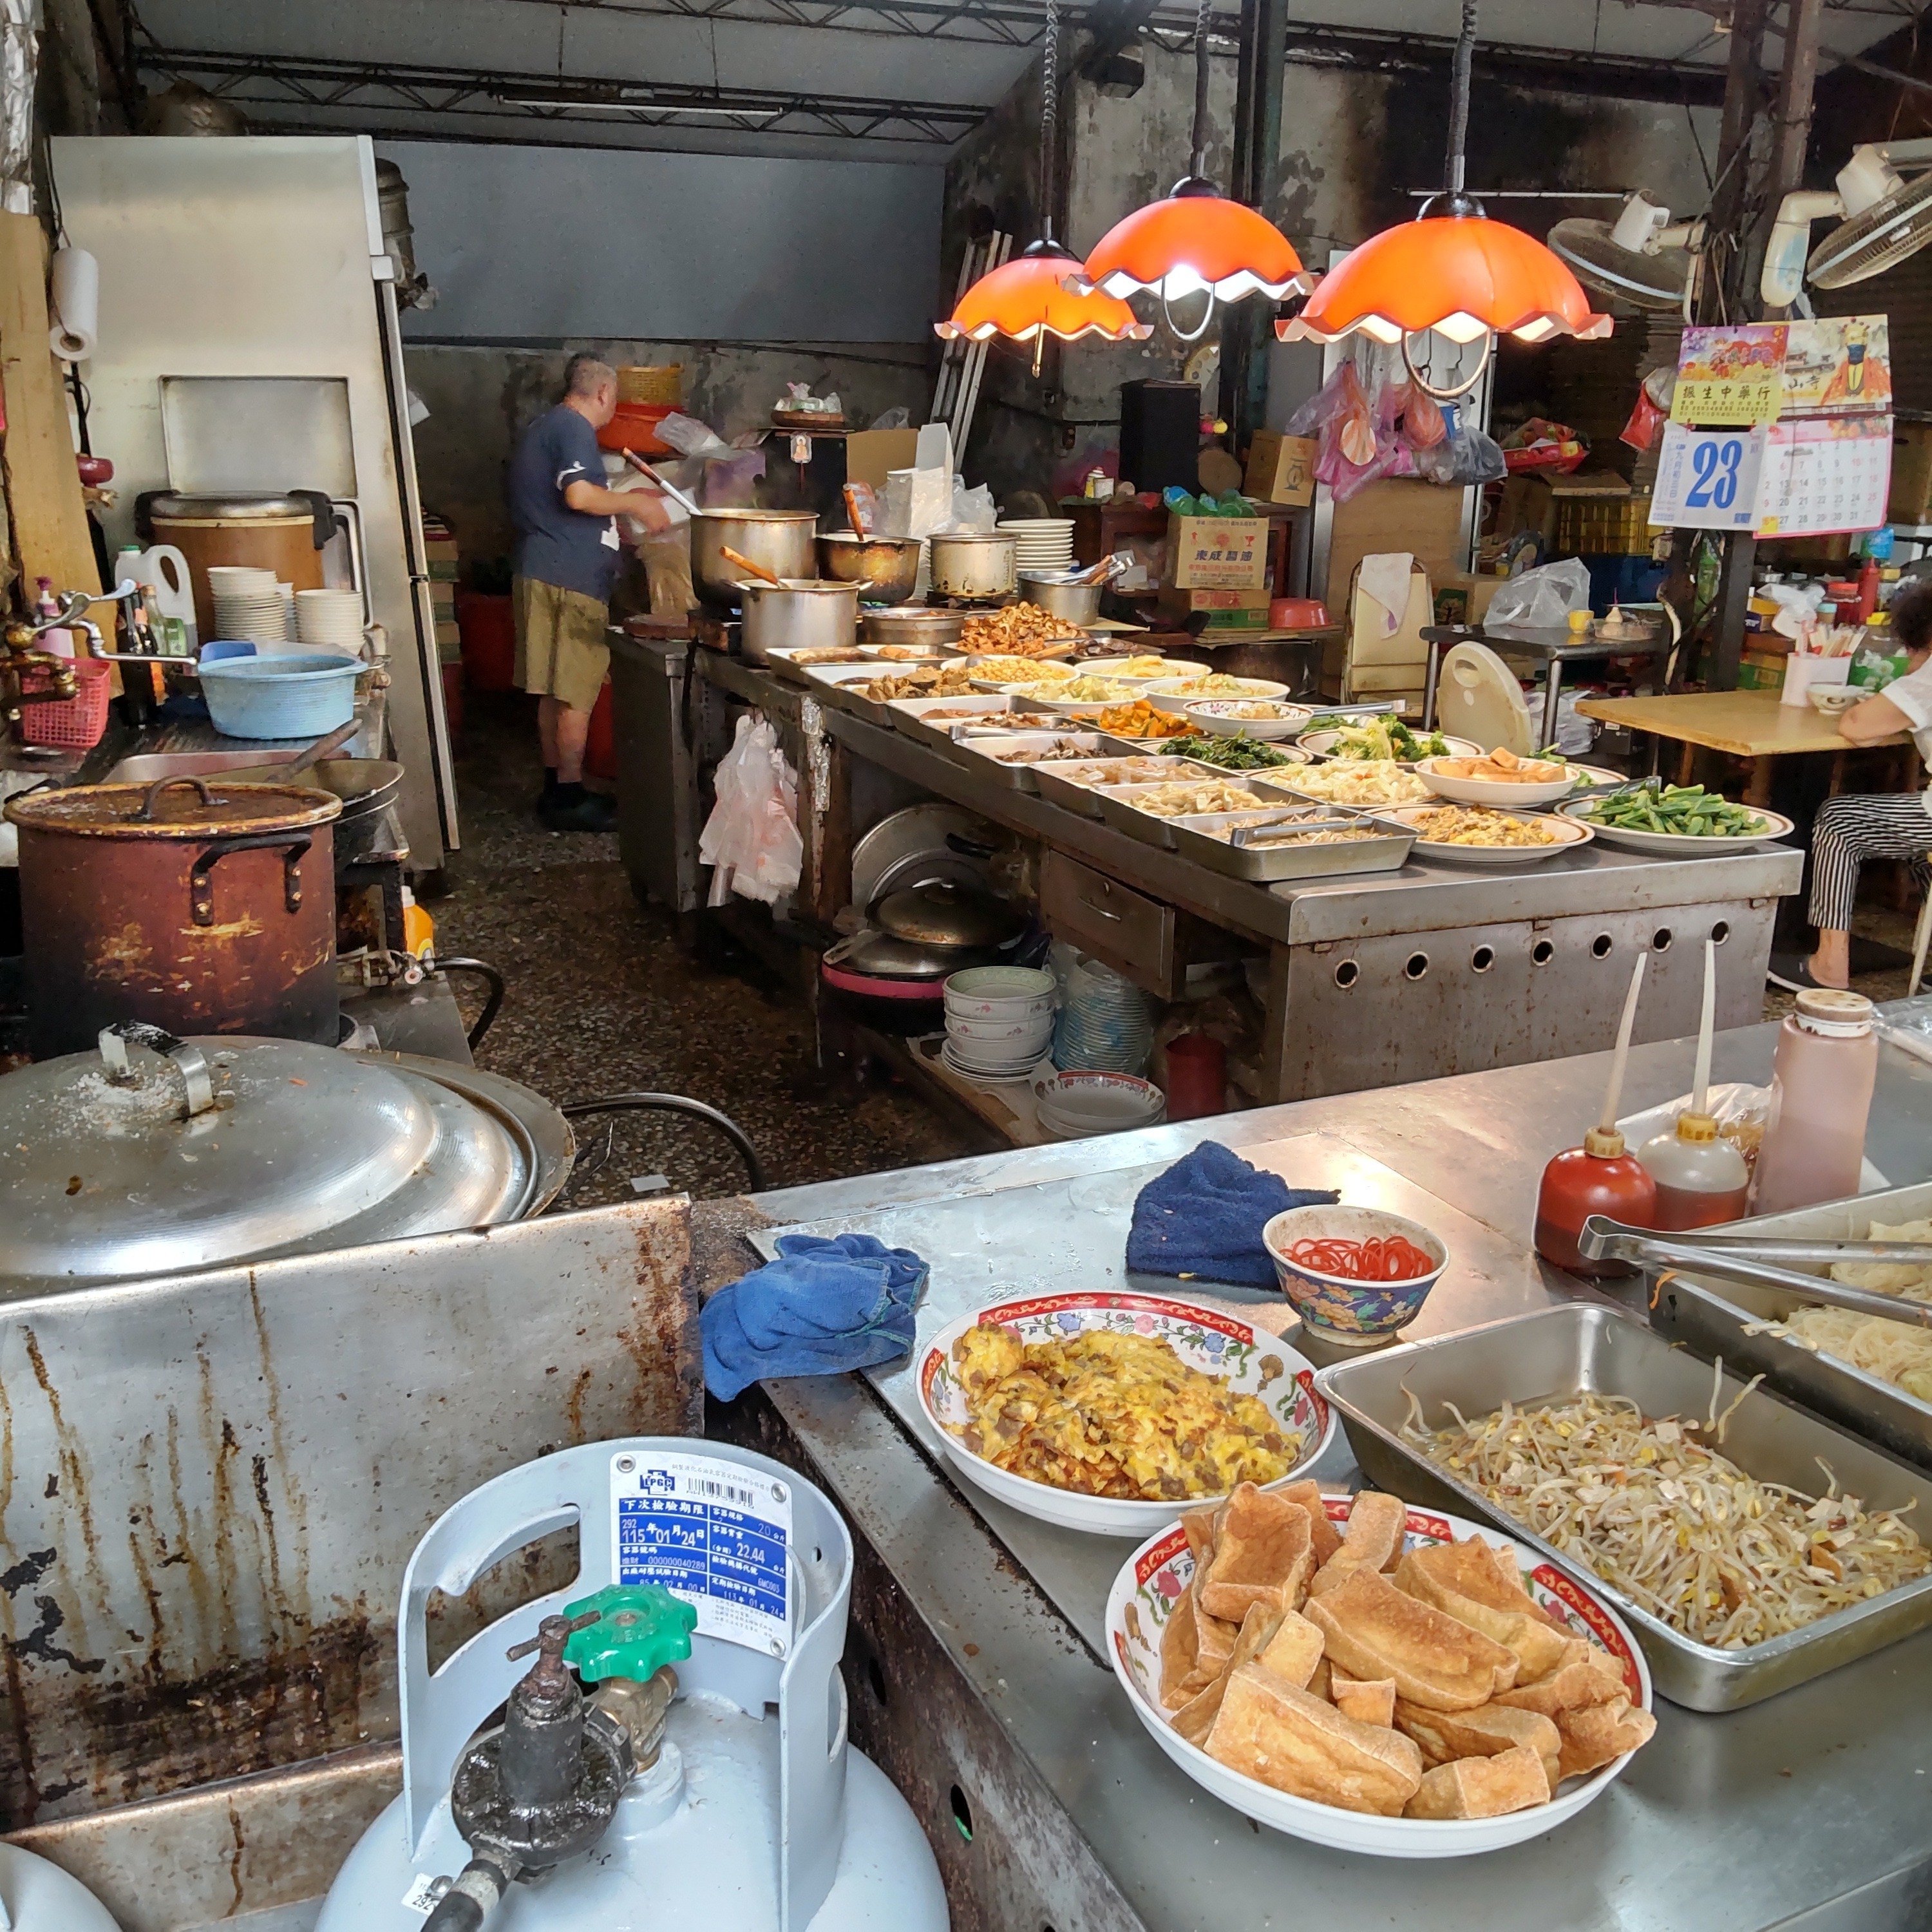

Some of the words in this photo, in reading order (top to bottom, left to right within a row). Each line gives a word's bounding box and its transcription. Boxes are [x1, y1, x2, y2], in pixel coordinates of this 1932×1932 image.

[1780, 462, 1786, 471] 6
[1685, 440, 1742, 509] 23
[1779, 498, 1789, 506] 20
[1799, 497, 1808, 505] 21
[1835, 495, 1844, 503] 23
[1868, 493, 1877, 501] 25
[1779, 516, 1788, 524] 27
[1799, 515, 1808, 523] 28
[645, 1478, 672, 1487] LPGC
[624, 1499, 704, 1514] 下次檢驗期限
[621, 1519, 637, 1529] 292
[758, 1523, 771, 1536] 20
[736, 1542, 765, 1564] 22.44
